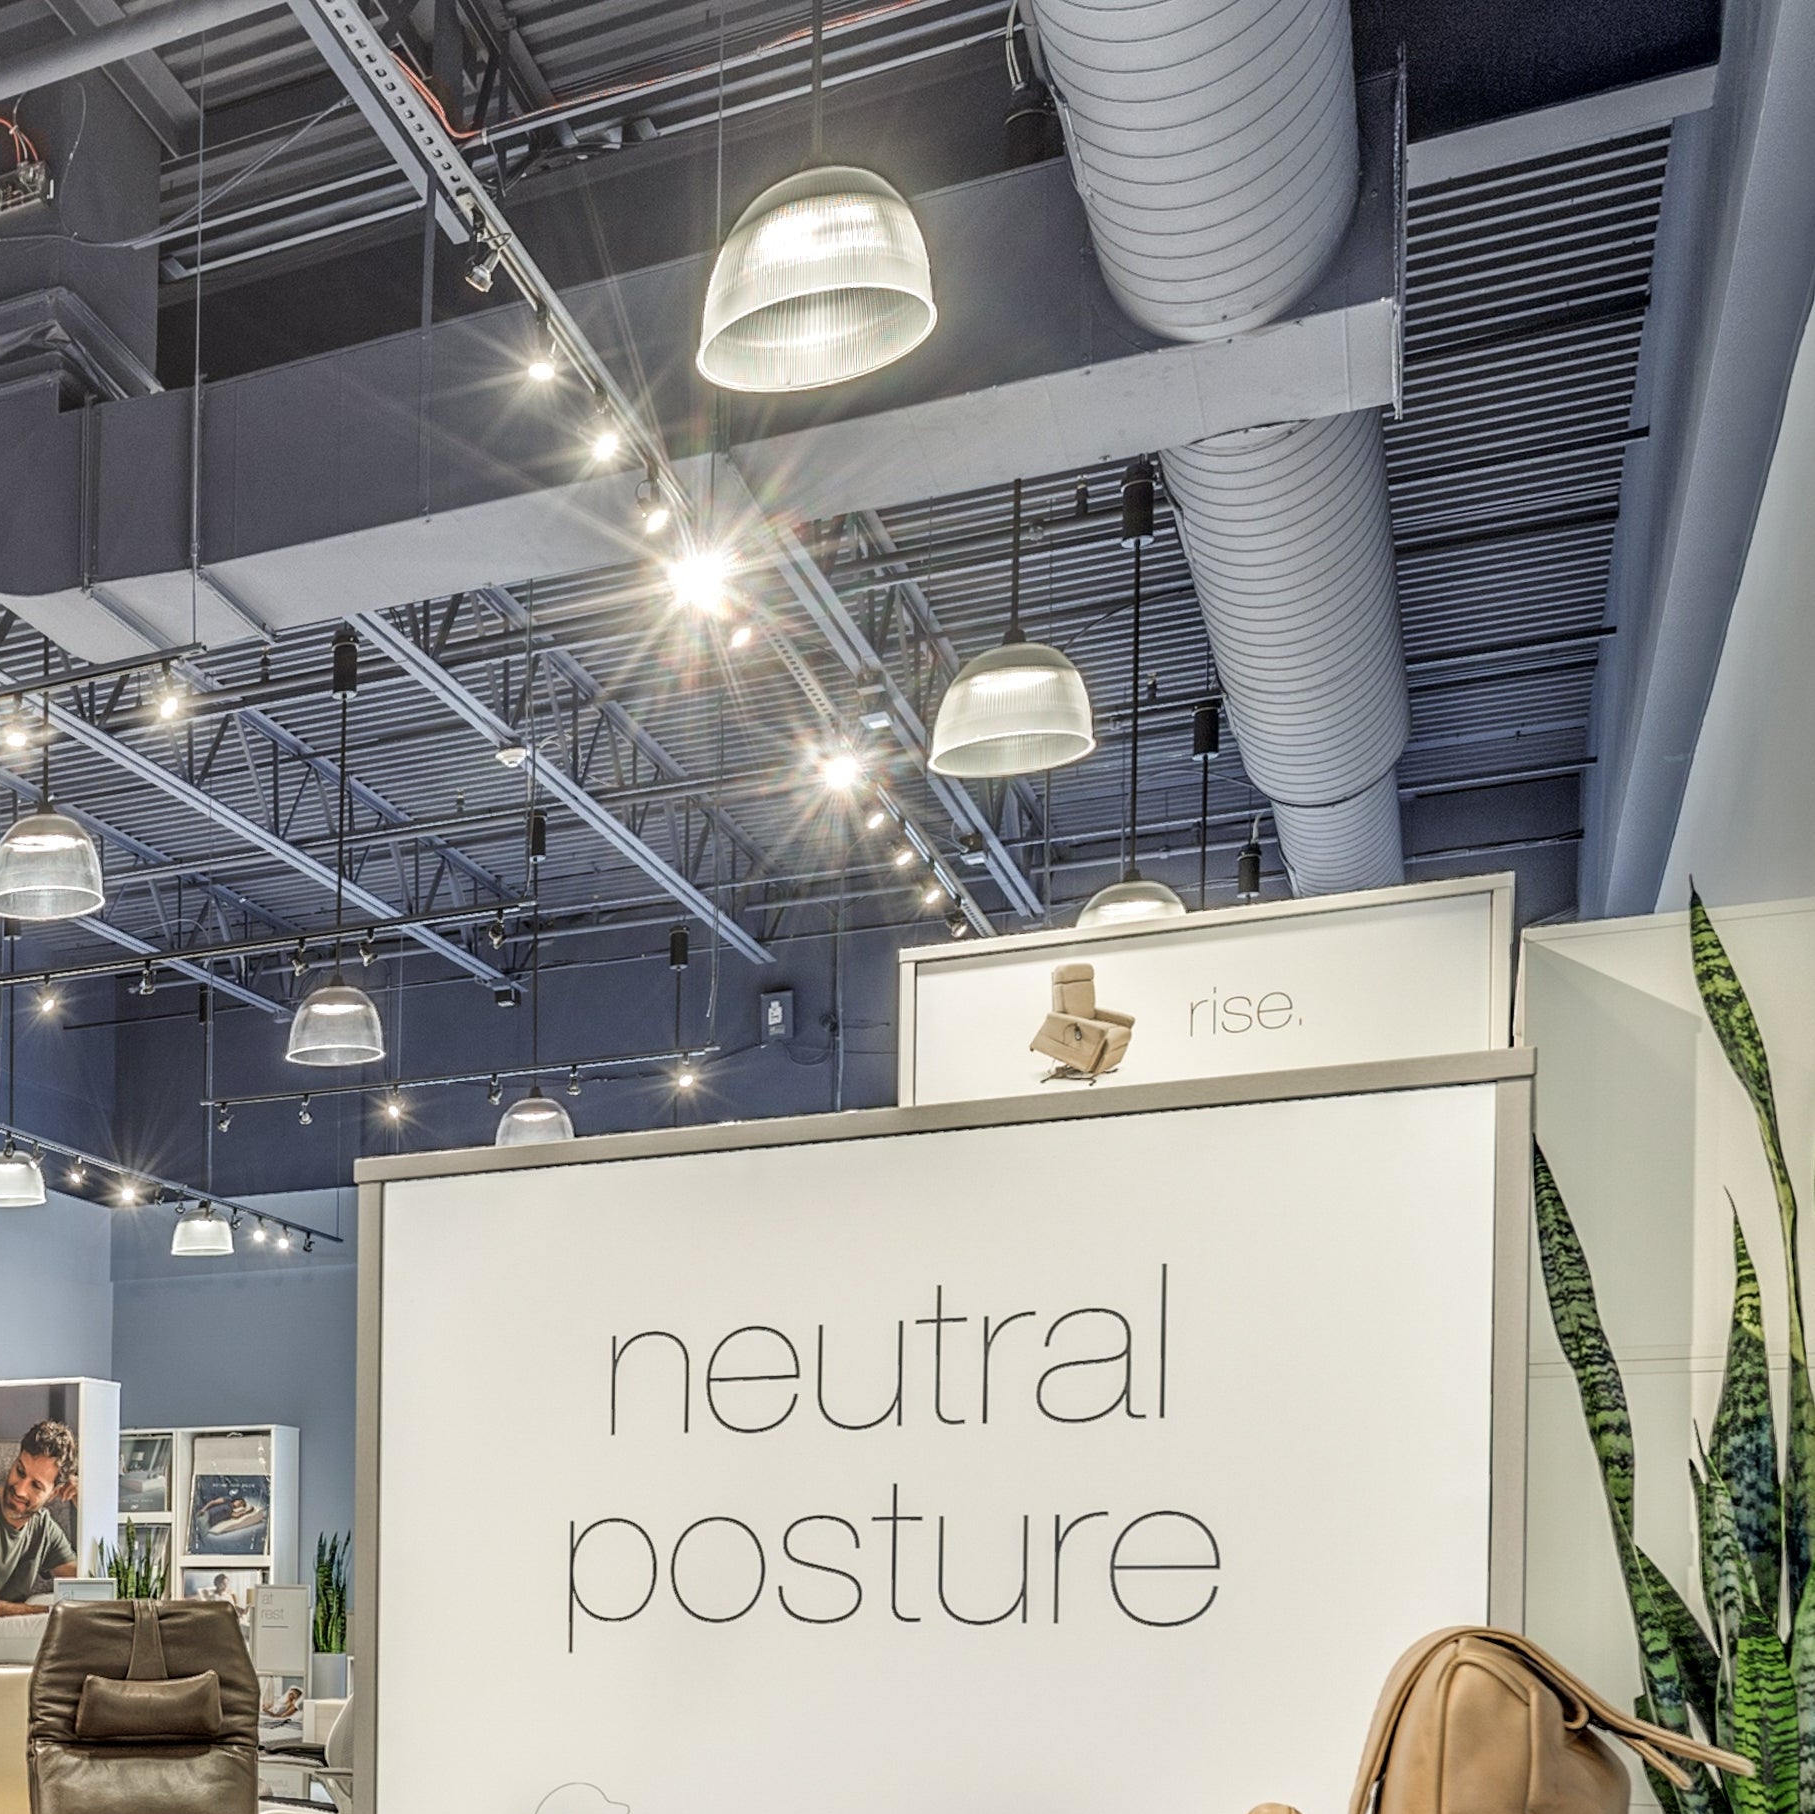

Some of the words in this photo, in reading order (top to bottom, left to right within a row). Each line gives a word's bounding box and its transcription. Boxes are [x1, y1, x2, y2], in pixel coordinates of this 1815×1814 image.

[1189, 986, 1303, 1038] rise.
[610, 1262, 1168, 1437] neutral
[567, 1482, 1222, 1655] posture
